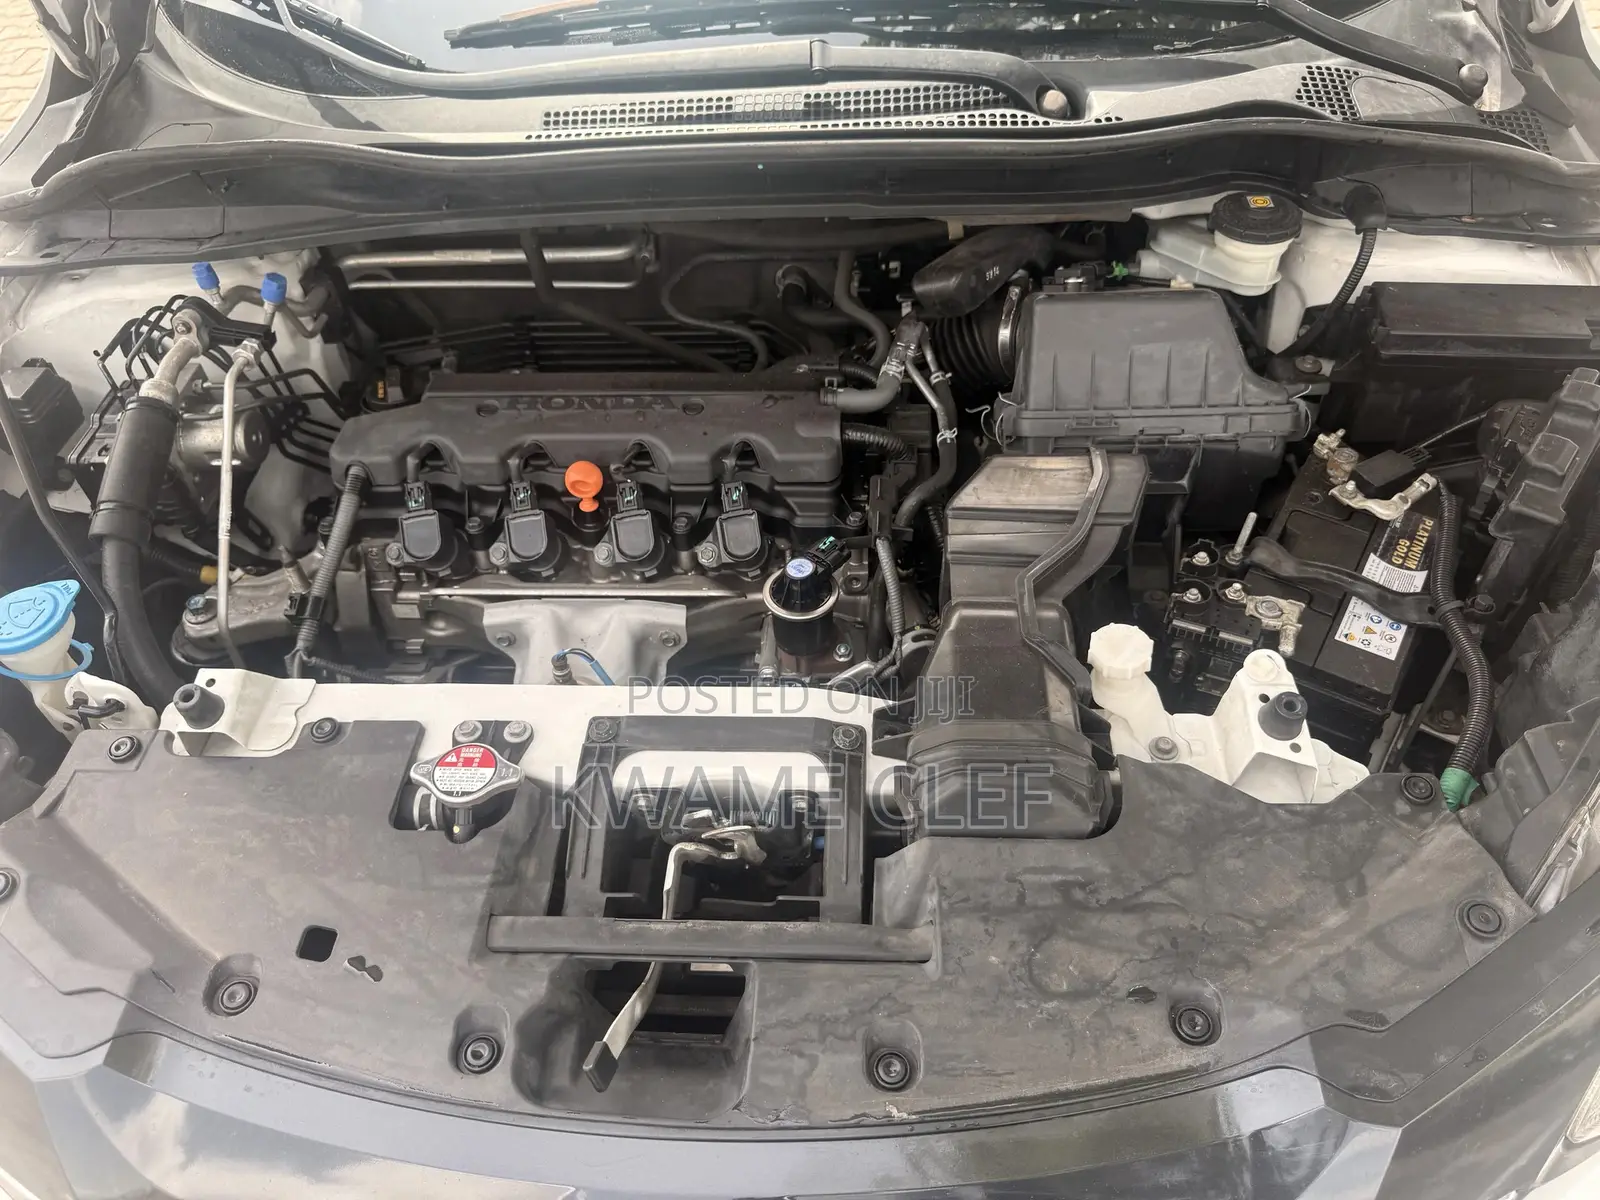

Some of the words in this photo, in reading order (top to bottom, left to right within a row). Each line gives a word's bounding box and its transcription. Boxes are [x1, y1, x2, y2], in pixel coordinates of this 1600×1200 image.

[502, 395, 679, 412] HONDA
[1392, 538, 1410, 565] GOLD
[1404, 515, 1434, 569] PLATINUM
